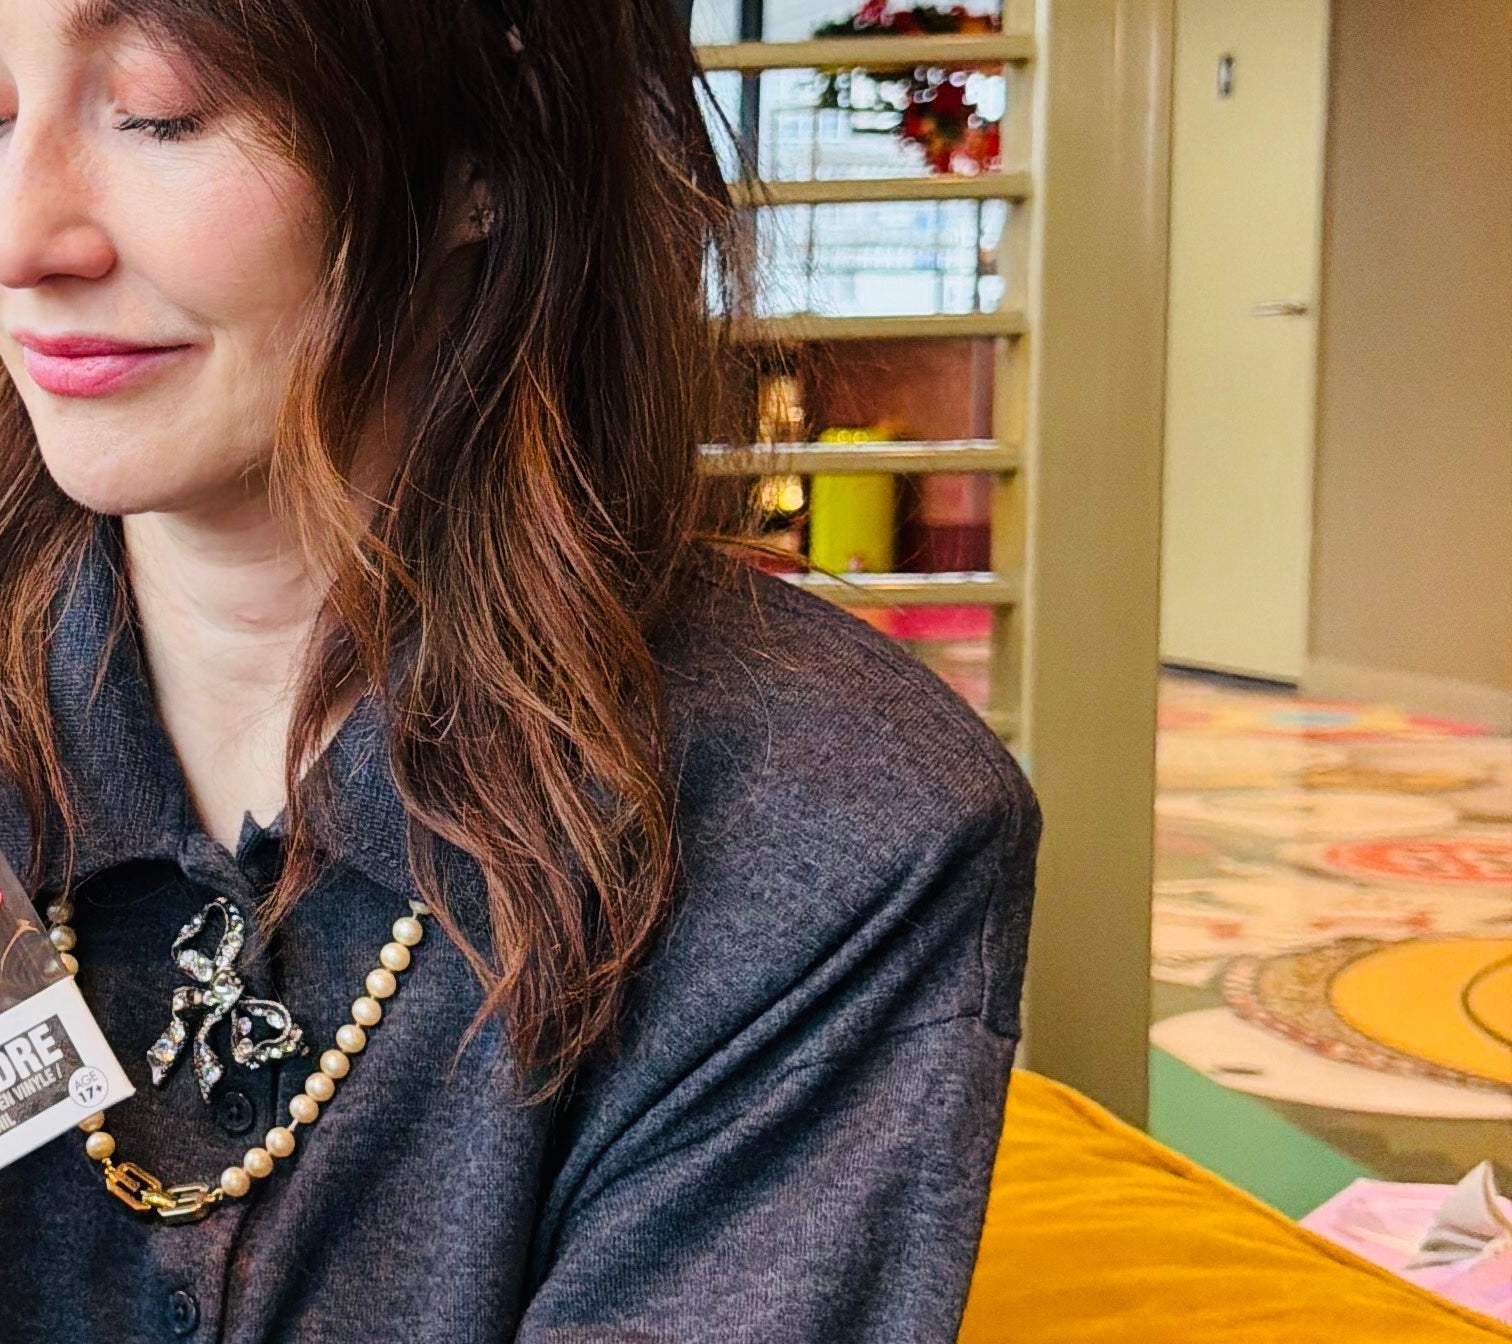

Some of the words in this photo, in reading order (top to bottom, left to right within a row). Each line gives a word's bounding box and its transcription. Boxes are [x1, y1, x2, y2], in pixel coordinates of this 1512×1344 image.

[12, 1071, 55, 1102] VINYLE
[74, 1070, 100, 1089] AGE
[77, 1084, 104, 1103] 17+
